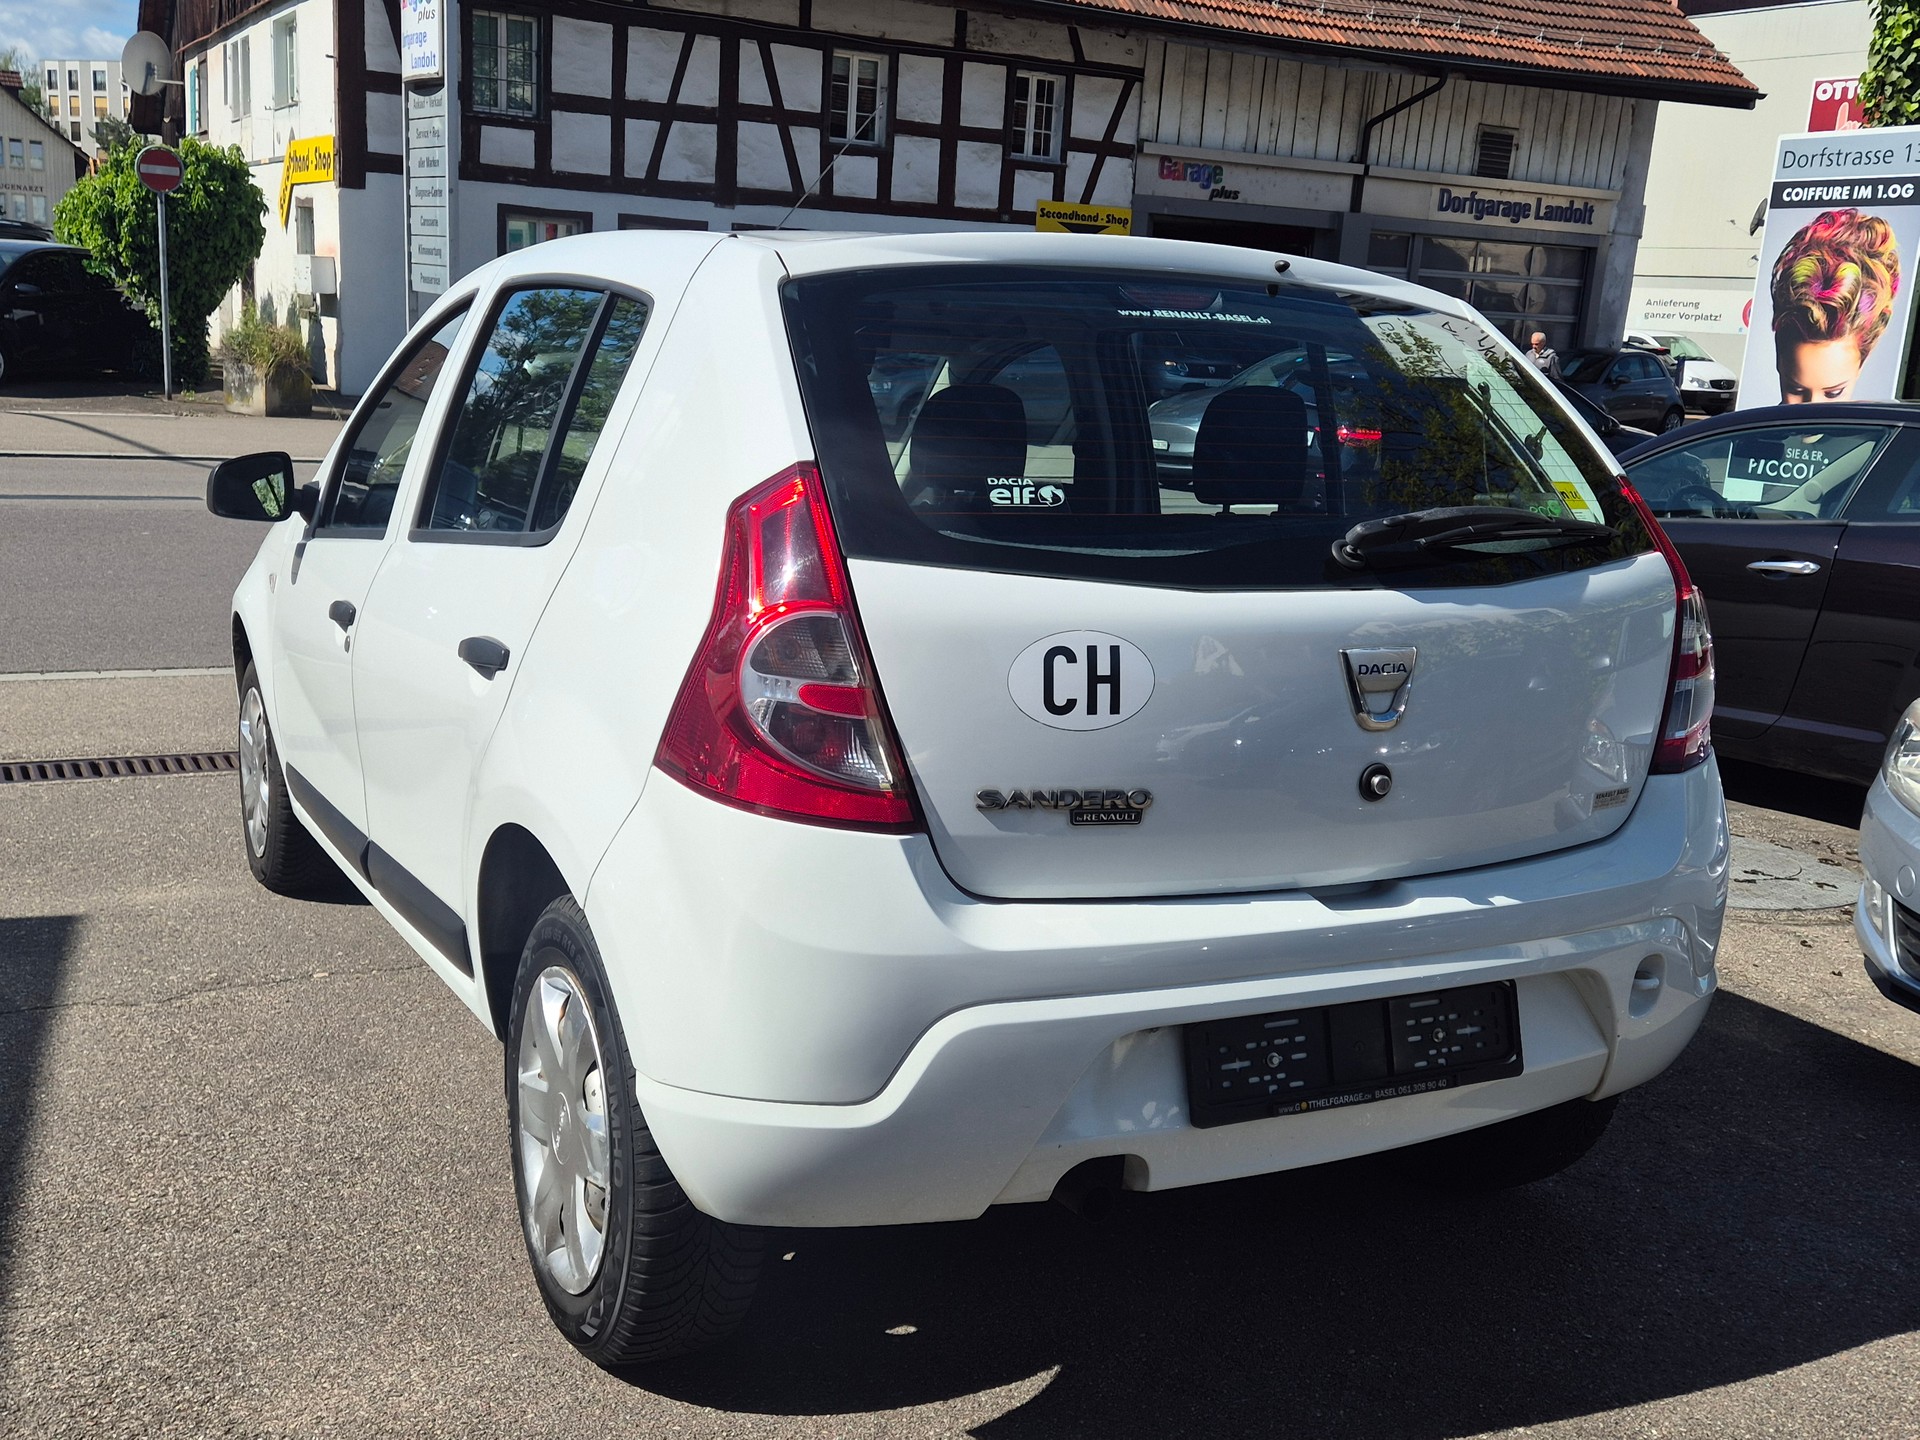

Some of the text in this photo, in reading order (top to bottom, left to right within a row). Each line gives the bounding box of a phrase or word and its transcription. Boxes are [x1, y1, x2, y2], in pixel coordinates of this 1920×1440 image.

[418, 7, 436, 24] plus
[411, 51, 436, 70] Landolt
[1816, 81, 1862, 101] OTT
[314, 146, 332, 177] Shop
[1782, 147, 1894, 169] Dorfstrasse
[1158, 155, 1224, 190] Garage
[1208, 185, 1240, 201] plus
[1782, 183, 1915, 201] COIFFURE IM 1.OG
[1437, 187, 1595, 225] Dorfgarage Landolt
[1039, 207, 1100, 223] Secondhand
[1105, 213, 1129, 229] Shop
[1645, 298, 1701, 309] Anlieferung
[1117, 309, 1272, 325] www.RENAULT-BASEL.ch
[1644, 311, 1722, 322] ganzer Vorplatz!
[1786, 447, 1801, 459] SIE
[1802, 449, 1809, 460] &
[987, 477, 1034, 486] DACIA
[989, 486, 1036, 505] elf
[1358, 662, 1407, 675] DACIA
[1043, 644, 1121, 716] CH
[975, 787, 1153, 810] SANDERO
[1083, 811, 1138, 821] RENAULT
[1375, 1088, 1397, 1099] BASEL
[1398, 1085, 1411, 1095] 061
[1413, 1083, 1426, 1093] 308
[1427, 1081, 1437, 1090] 90
[1438, 1079, 1447, 1088] 40
[601, 1040, 624, 1188] KUMHO
